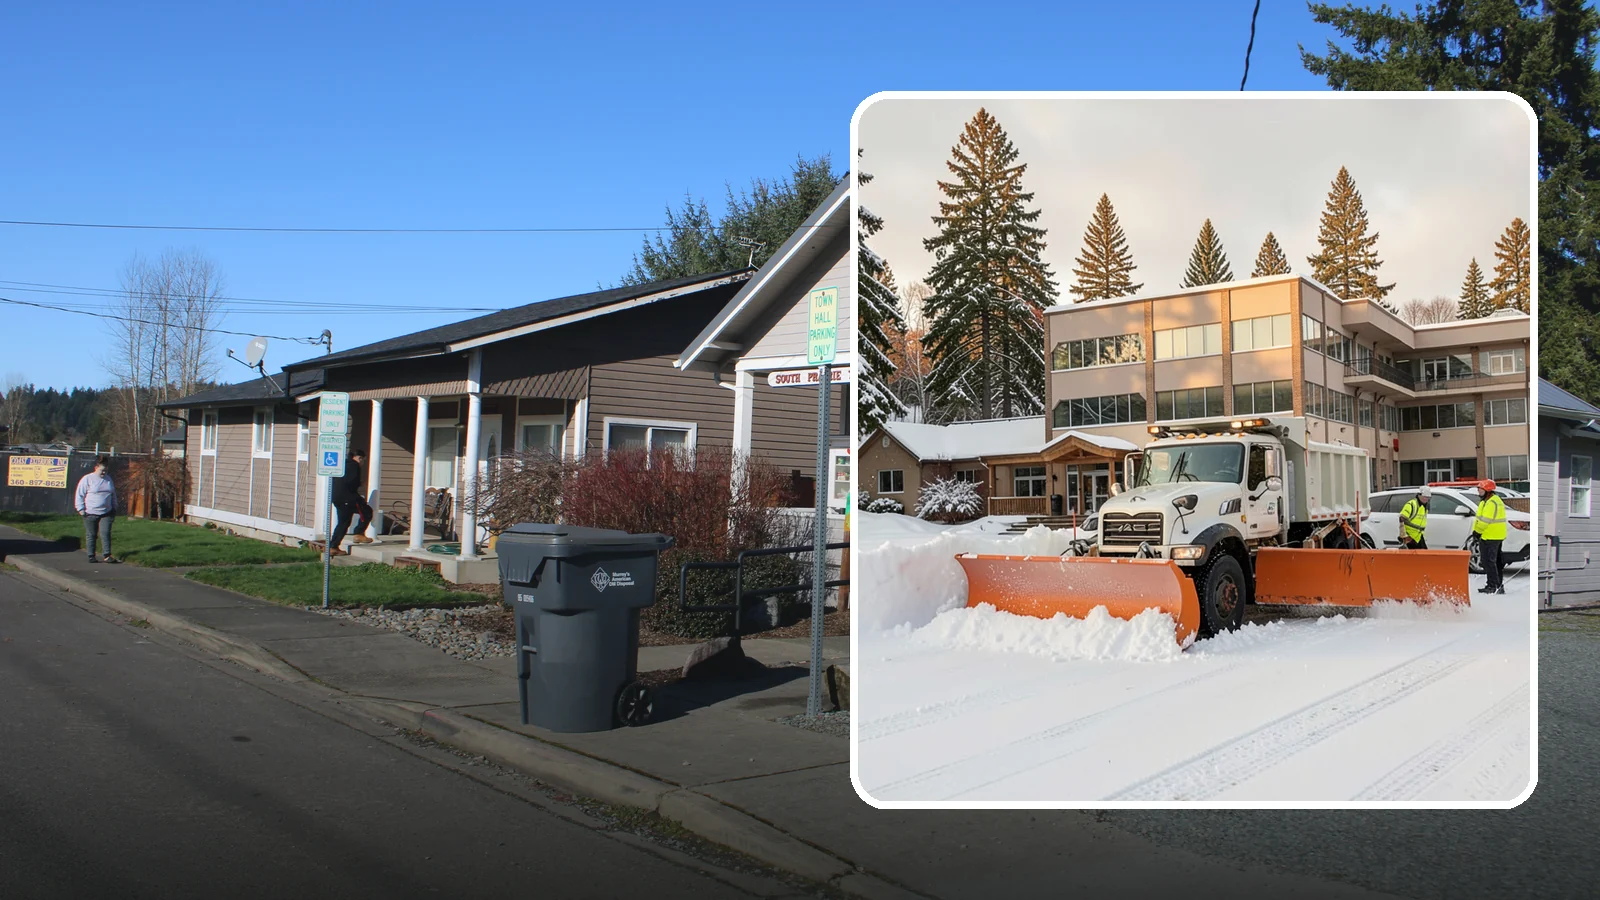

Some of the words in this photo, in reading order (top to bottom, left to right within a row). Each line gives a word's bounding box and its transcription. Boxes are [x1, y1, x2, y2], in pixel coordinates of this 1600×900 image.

[815, 294, 833, 308] TOWN
[814, 311, 831, 324] HALL
[810, 326, 835, 341] PARKING
[813, 344, 831, 358] ONLY
[775, 373, 801, 384] SOUTH
[320, 436, 344, 444] RESERVED
